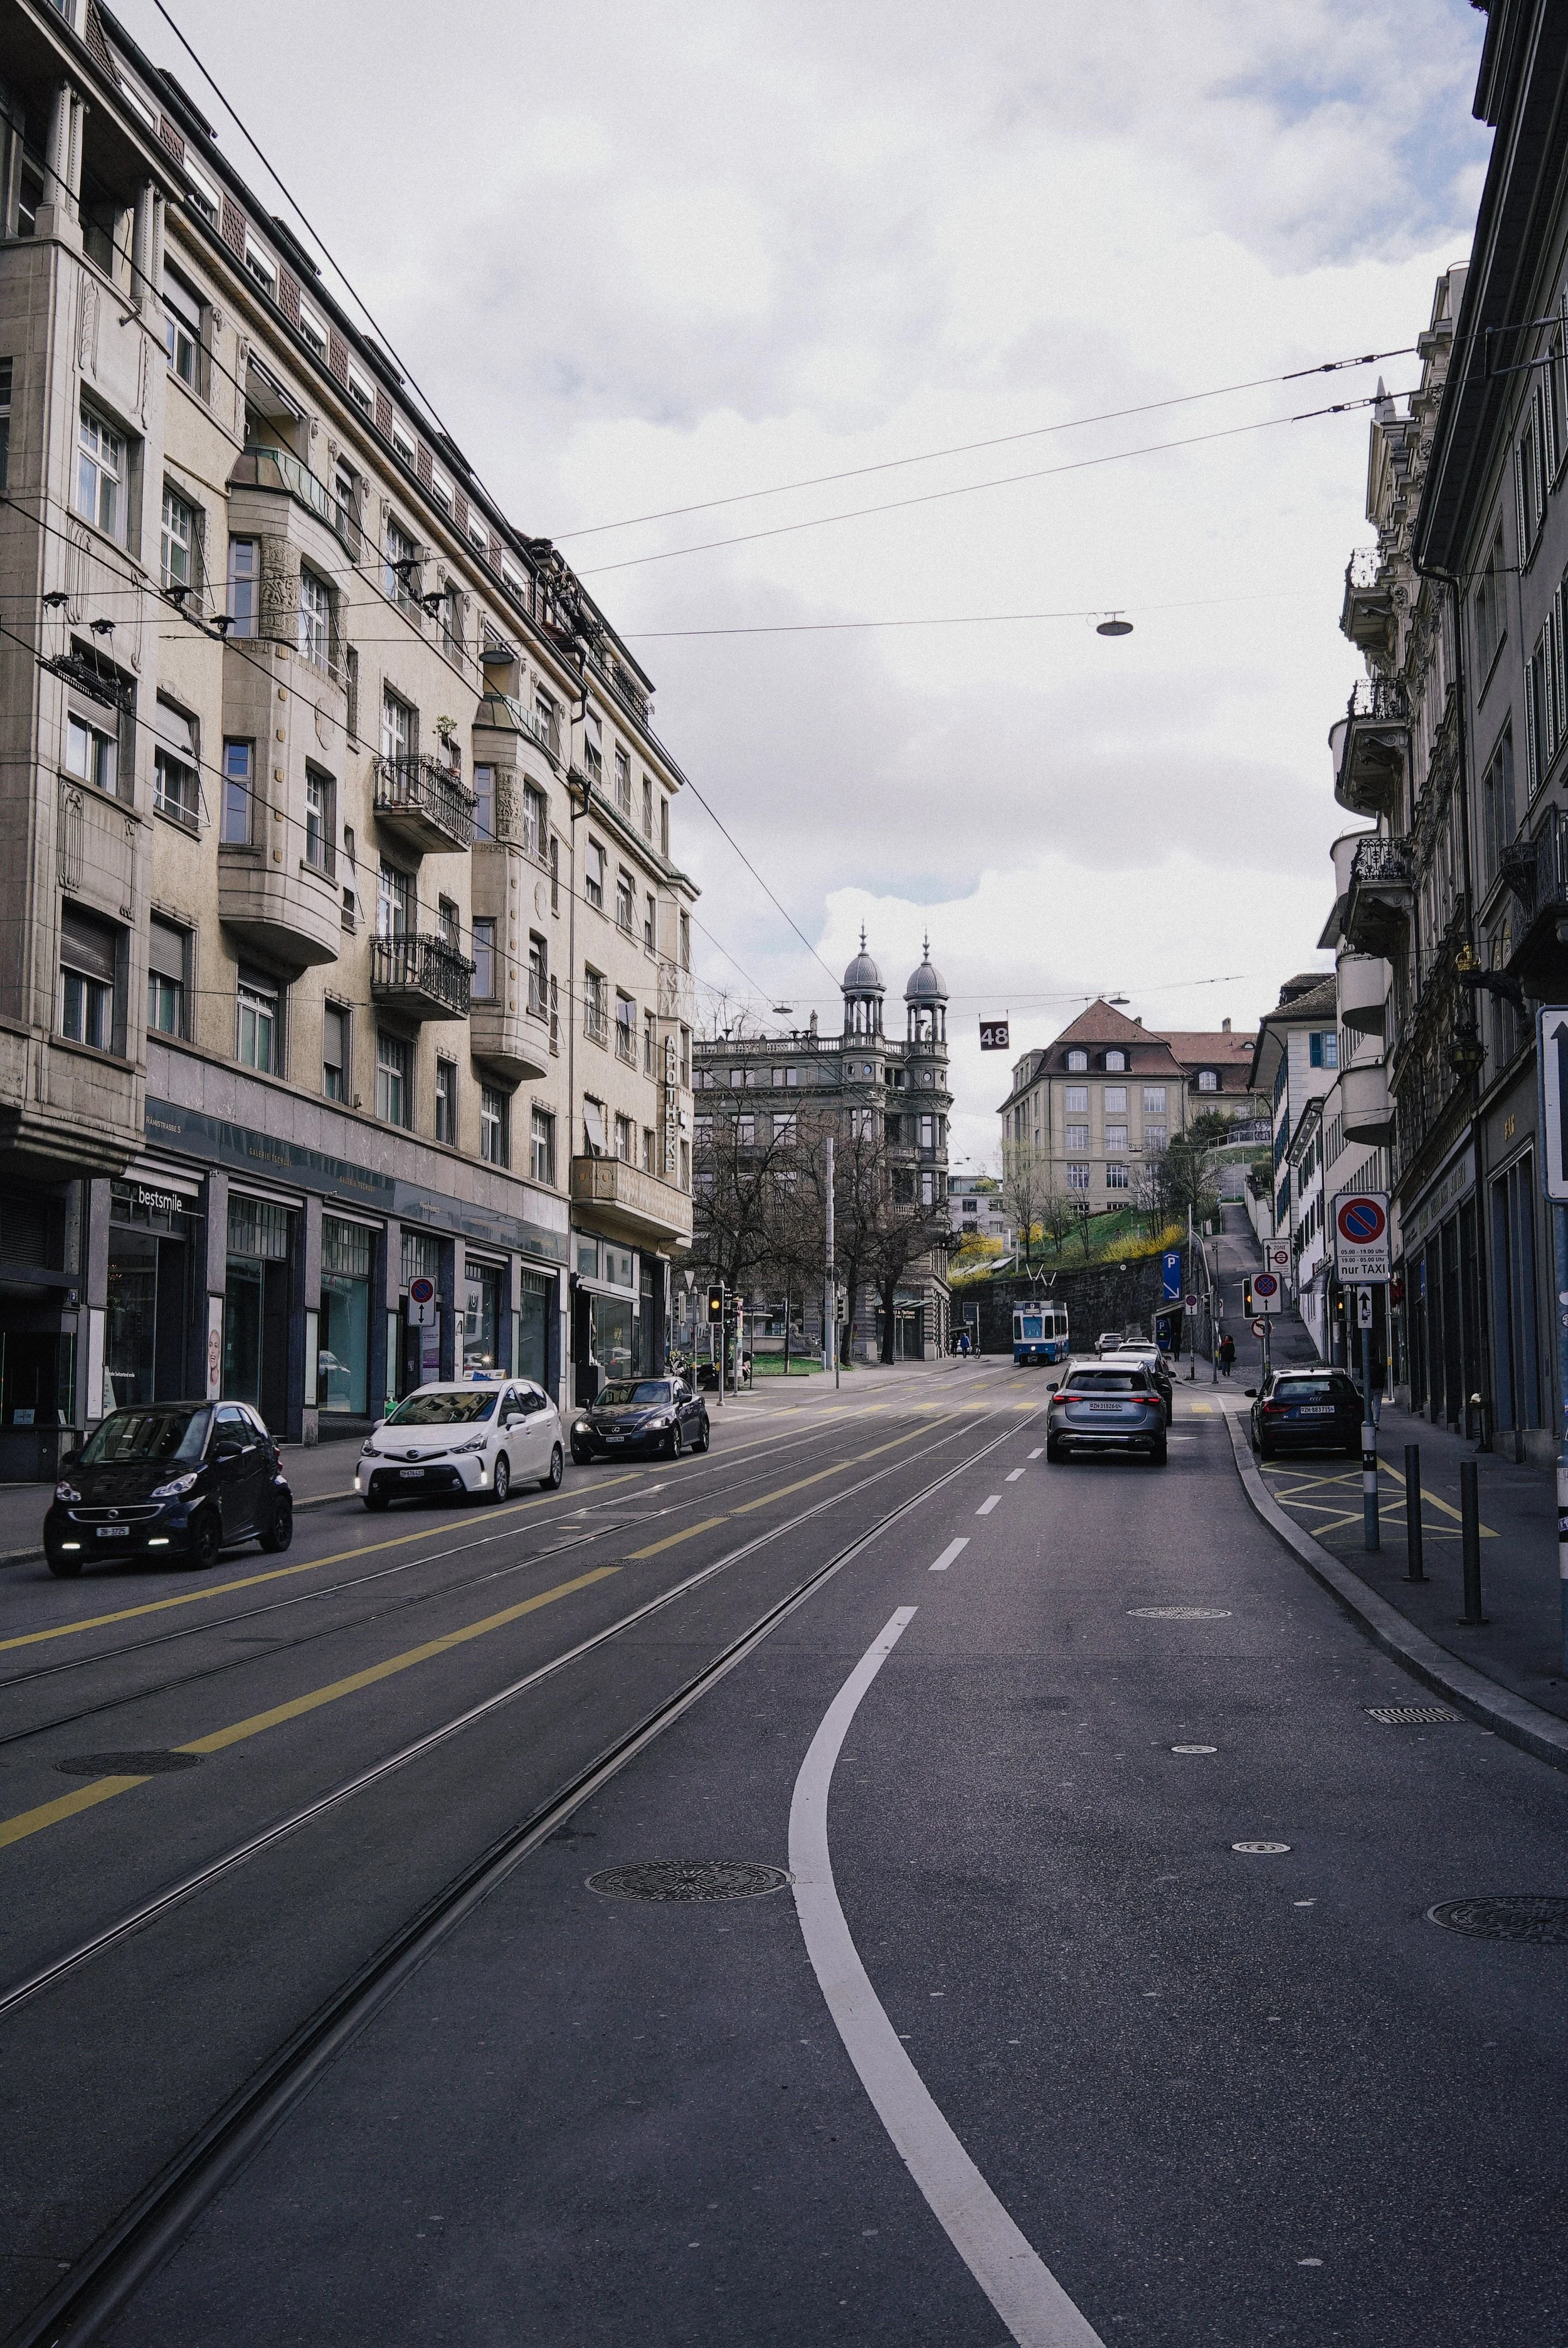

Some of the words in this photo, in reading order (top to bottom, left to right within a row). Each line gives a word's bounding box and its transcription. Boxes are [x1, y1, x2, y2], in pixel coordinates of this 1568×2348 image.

[981, 1028, 1009, 1045] 48
[665, 1035, 677, 1173] APOTHEKE
[146, 1116, 177, 1133] RÄMISTRASSE
[249, 1147, 270, 1159] GALERIE
[272, 1155, 292, 1167] TSCHUDI
[339, 1176, 356, 1187] GALERIE
[358, 1182, 376, 1193] TSCHUDI
[139, 1185, 182, 1212] bestsmile
[1168, 1257, 1175, 1268] P
[1362, 1264, 1385, 1273] TAXI
